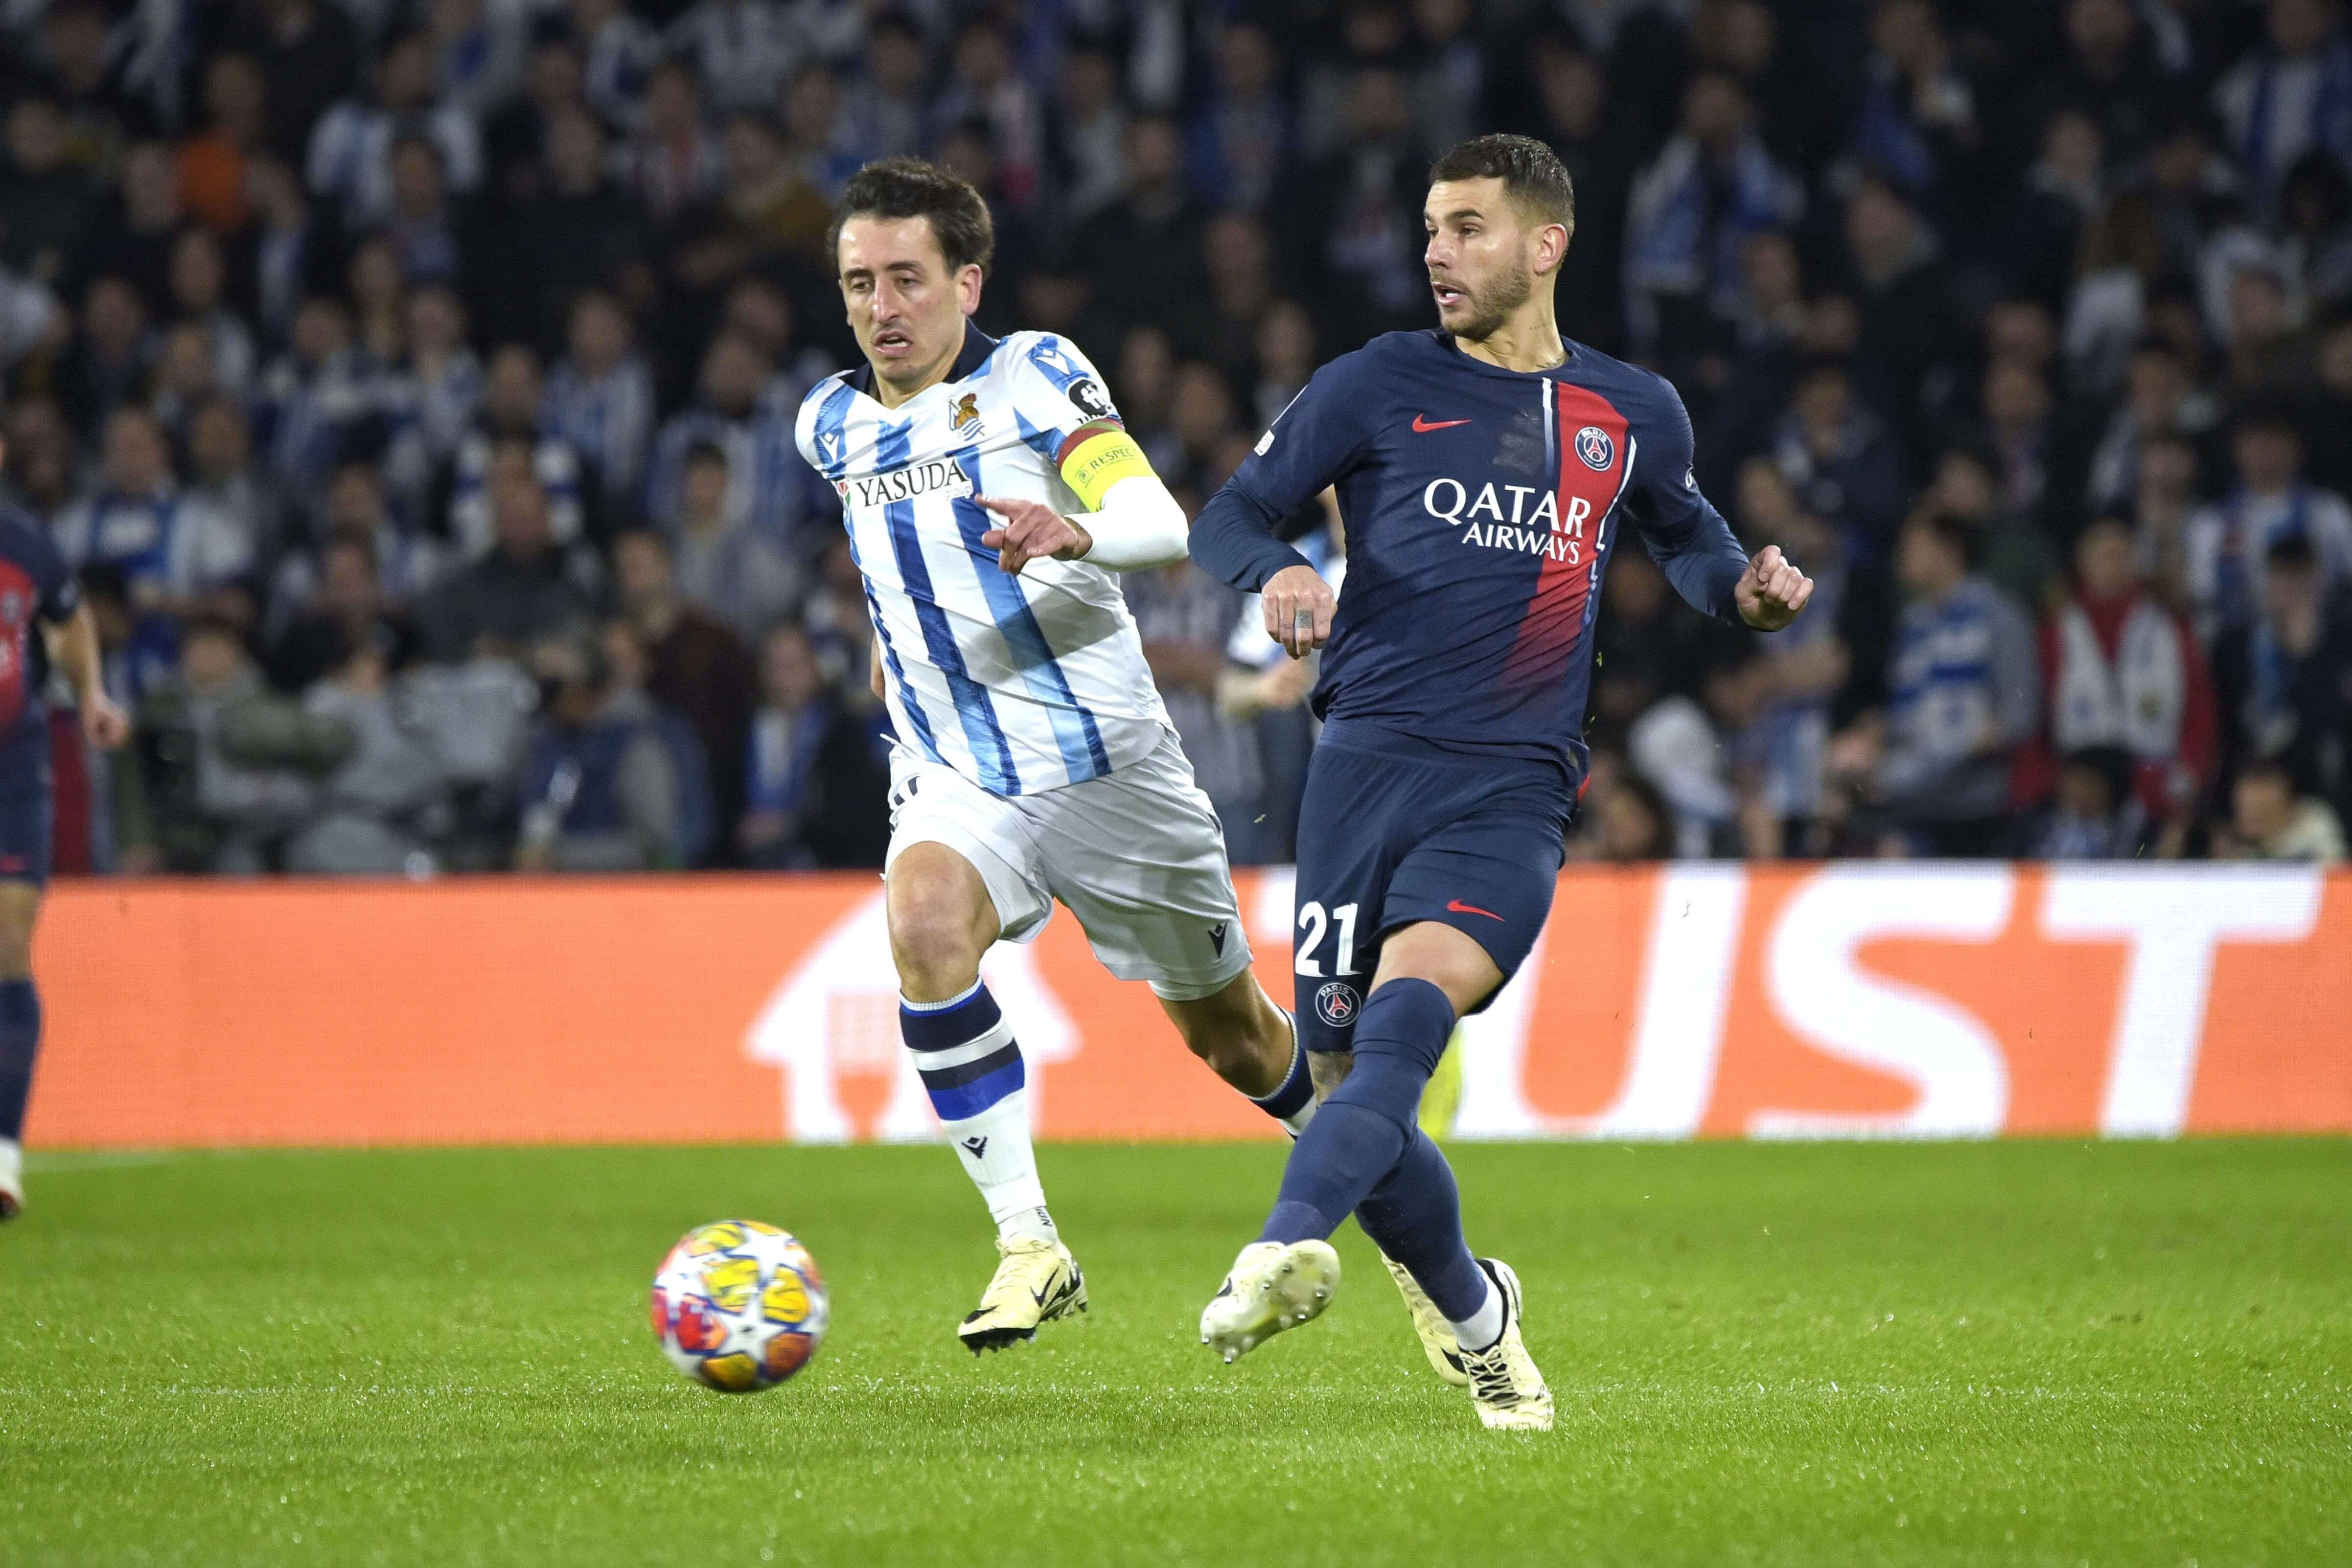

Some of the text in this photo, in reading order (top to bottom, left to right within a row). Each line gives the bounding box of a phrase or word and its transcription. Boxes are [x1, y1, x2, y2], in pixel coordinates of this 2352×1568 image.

[1581, 429, 1607, 442] PARIS
[855, 458, 969, 507] YASUDA
[1424, 478, 1591, 538] QATAR
[1461, 522, 1580, 565] AIRWAYS
[1295, 901, 1363, 977] 21
[1258, 863, 2322, 1141] UST
[1320, 985, 1349, 998] PARIS
